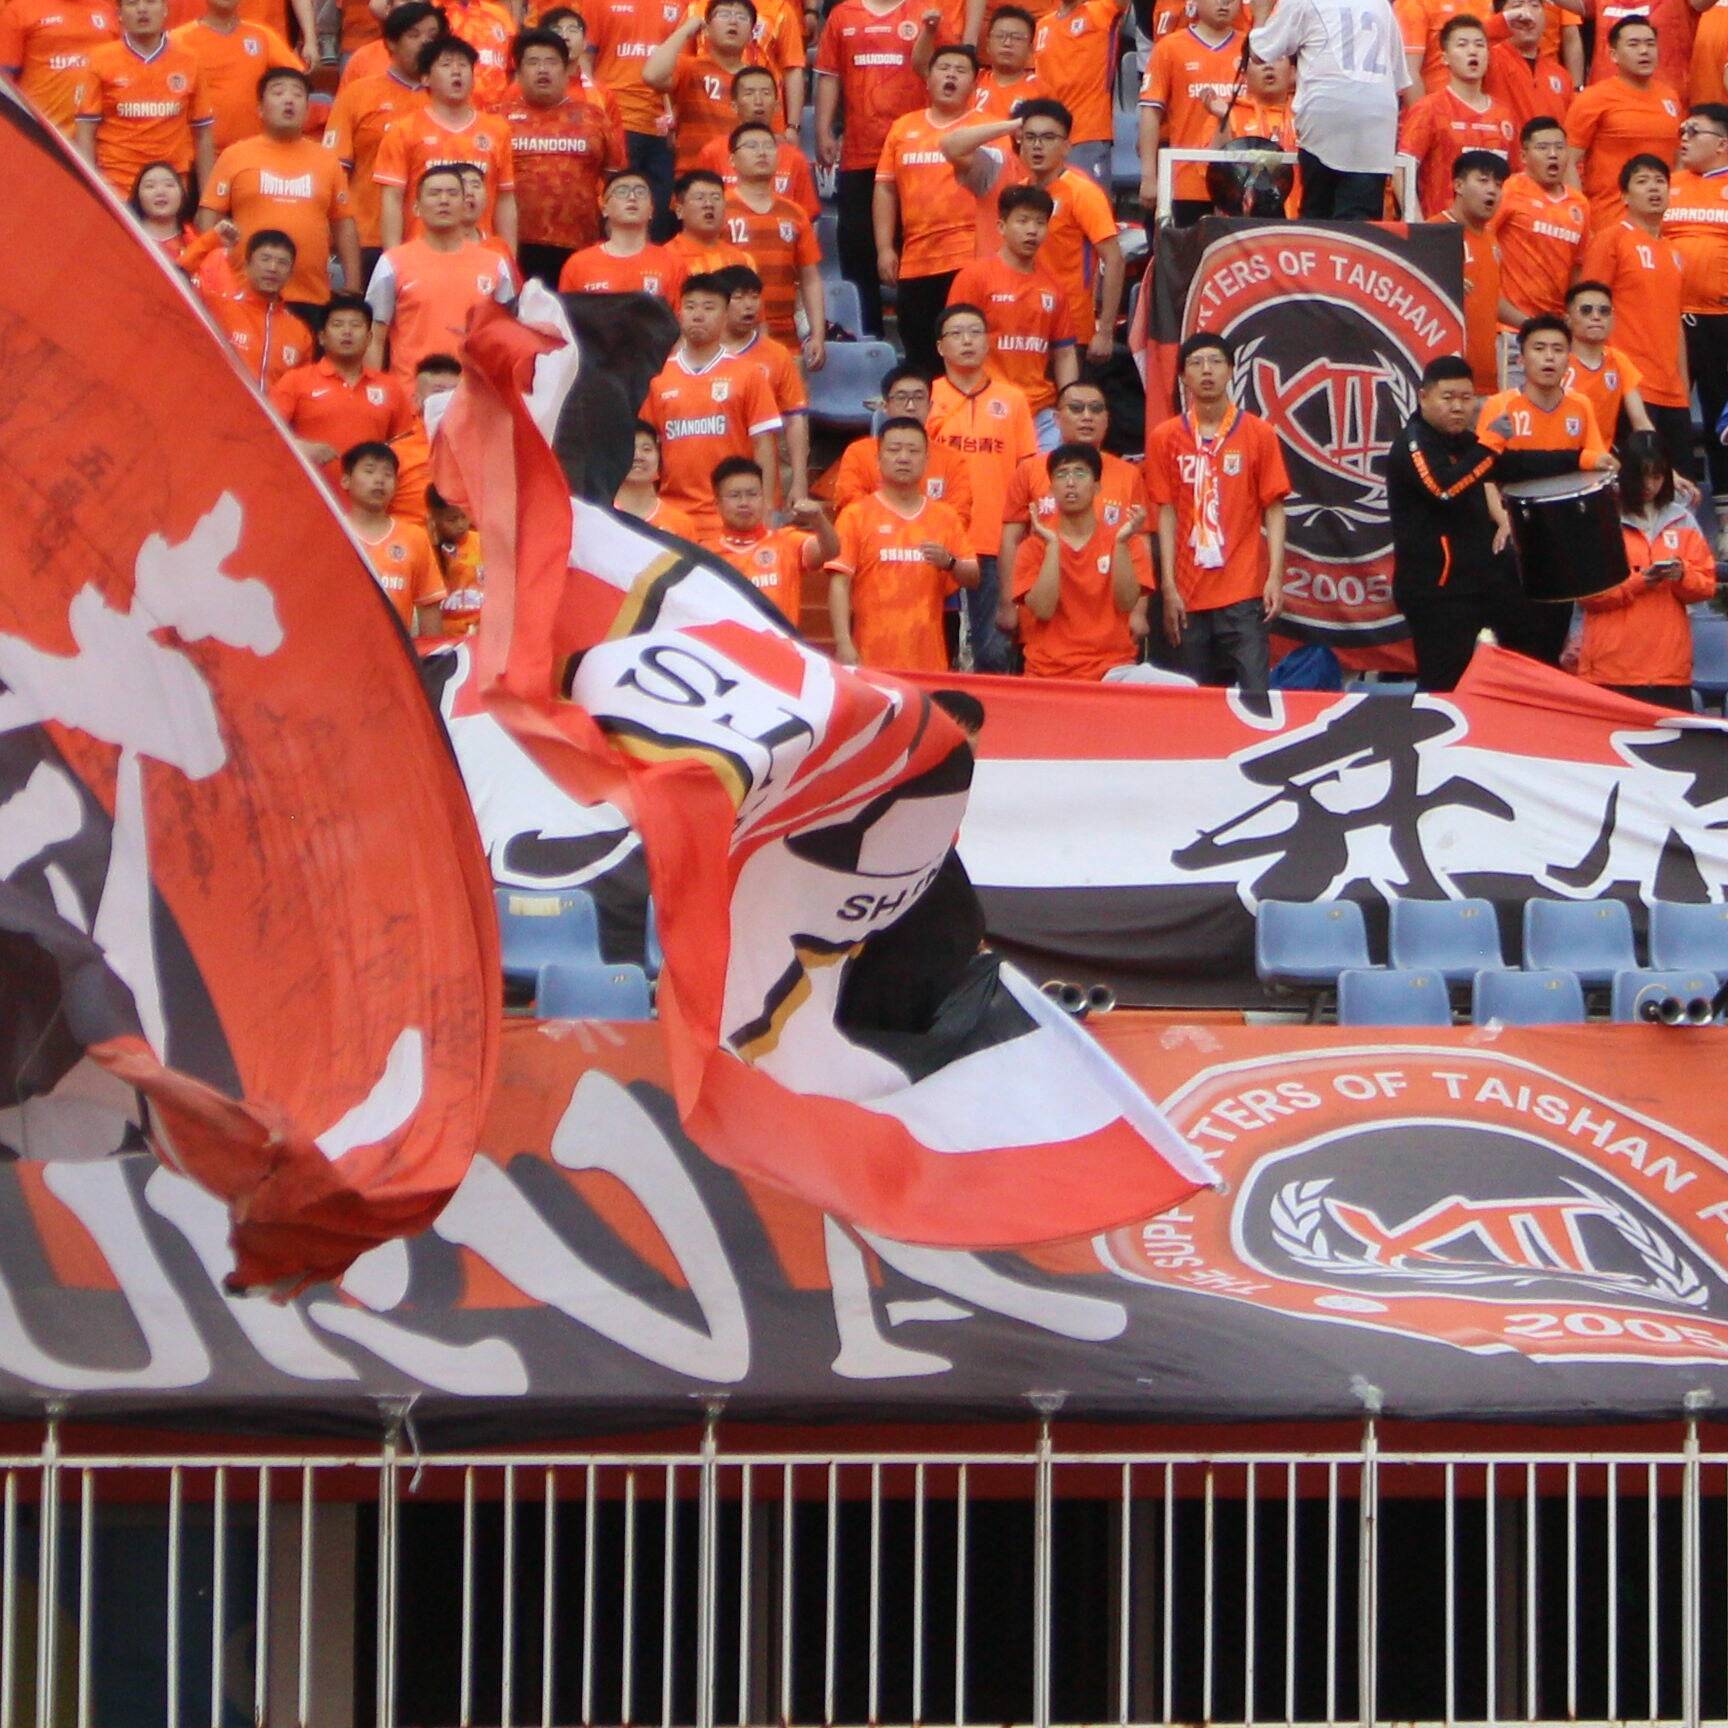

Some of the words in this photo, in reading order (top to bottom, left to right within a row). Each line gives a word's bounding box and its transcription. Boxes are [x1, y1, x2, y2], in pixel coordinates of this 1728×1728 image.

[1336, 3, 1391, 75] 12
[853, 53, 904, 66] SHANDONG
[702, 74, 721, 100] 12
[116, 101, 182, 117] SHANDONG
[510, 137, 587, 153] SHANDONG
[727, 219, 749, 243] 12
[1634, 244, 1655, 269] 12
[1277, 250, 1317, 277] OF
[1328, 254, 1448, 348] TAISHAN
[664, 412, 726, 436] SHANDONG
[1512, 409, 1532, 436] 12
[1174, 453, 1194, 480] 12
[1282, 566, 1393, 607] 2005
[1332, 1071, 1410, 1102] OF
[1433, 1070, 1699, 1196] TAISHAN
